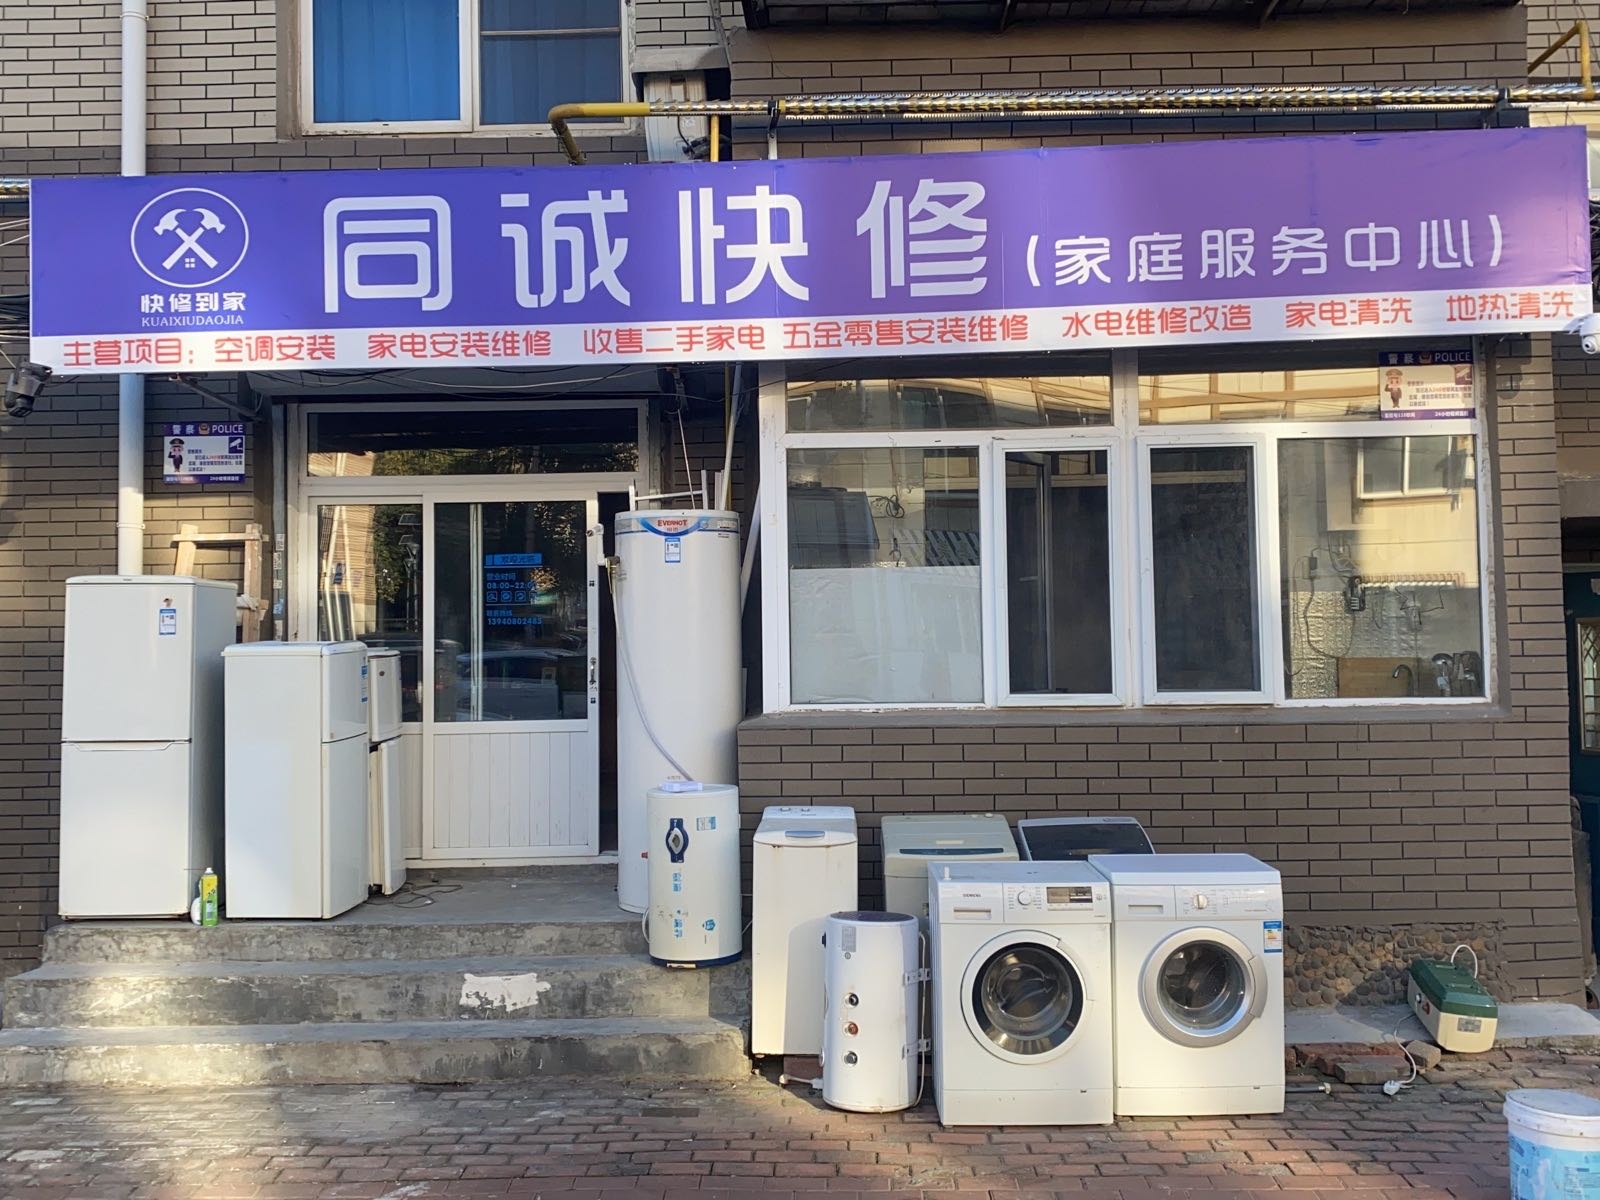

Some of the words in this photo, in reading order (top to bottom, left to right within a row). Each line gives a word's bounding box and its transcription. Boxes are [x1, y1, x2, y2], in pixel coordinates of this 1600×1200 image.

[324, 178, 988, 314] 同诚快修
[1026, 214, 1504, 288] （家庭服务中心）
[140, 292, 246, 314] 快修到家
[141, 314, 244, 327] KUAIXIUDAOJIA
[368, 330, 552, 360] 家电安装维修
[583, 324, 766, 355] 收售二手家电
[783, 314, 1029, 351] 五金零售安装维修
[1062, 303, 1252, 338] 水电维修改造
[1286, 297, 1413, 328] 家电清洗
[1446, 291, 1574, 322] 地热清洗
[1434, 351, 1471, 362] POLICE
[211, 424, 244, 434] POLICE
[657, 519, 688, 527] EVERHOT
